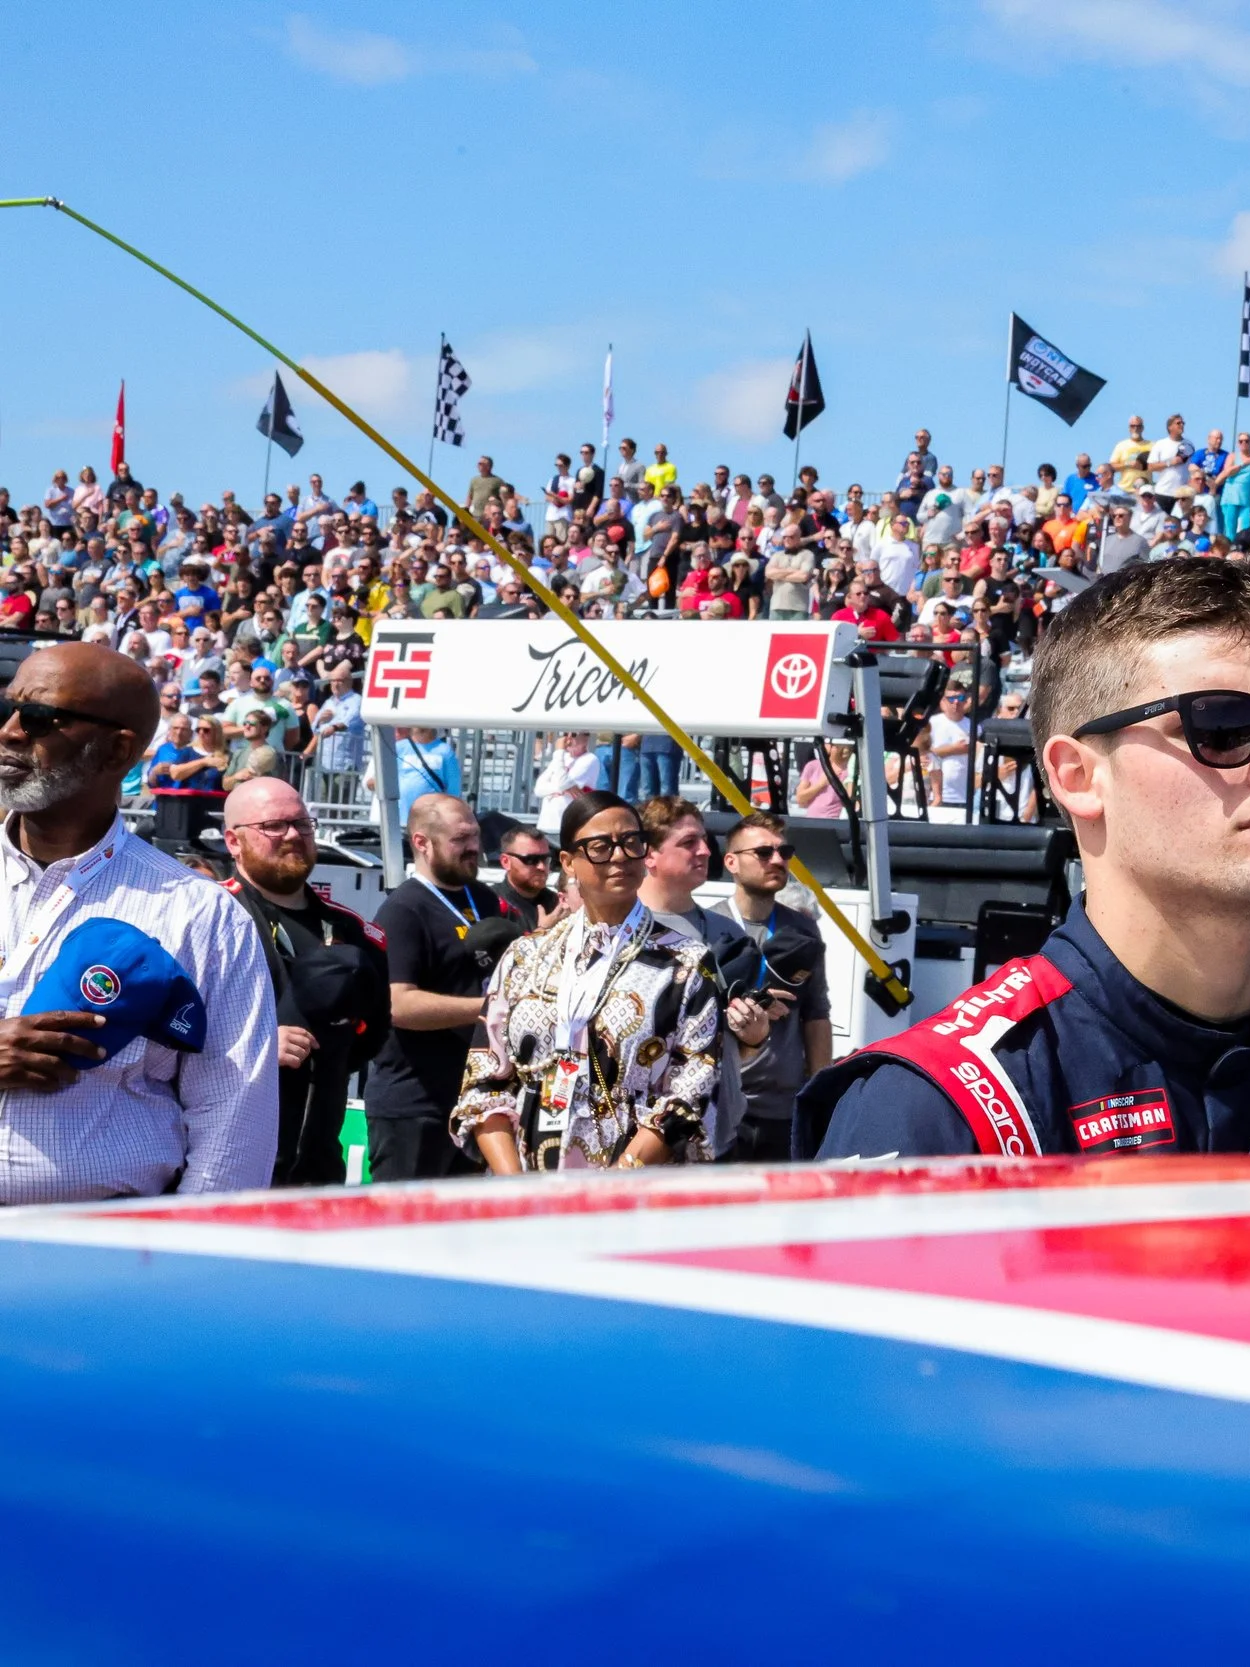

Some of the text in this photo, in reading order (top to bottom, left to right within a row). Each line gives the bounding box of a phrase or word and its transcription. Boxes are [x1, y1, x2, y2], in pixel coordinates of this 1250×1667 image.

[1020, 351, 1067, 386] INDYCAR
[512, 636, 659, 713] Tricon
[949, 1061, 1025, 1159] sparc
[1109, 1095, 1135, 1109] NASCAR
[1078, 1107, 1166, 1141] CRAFTSMAN
